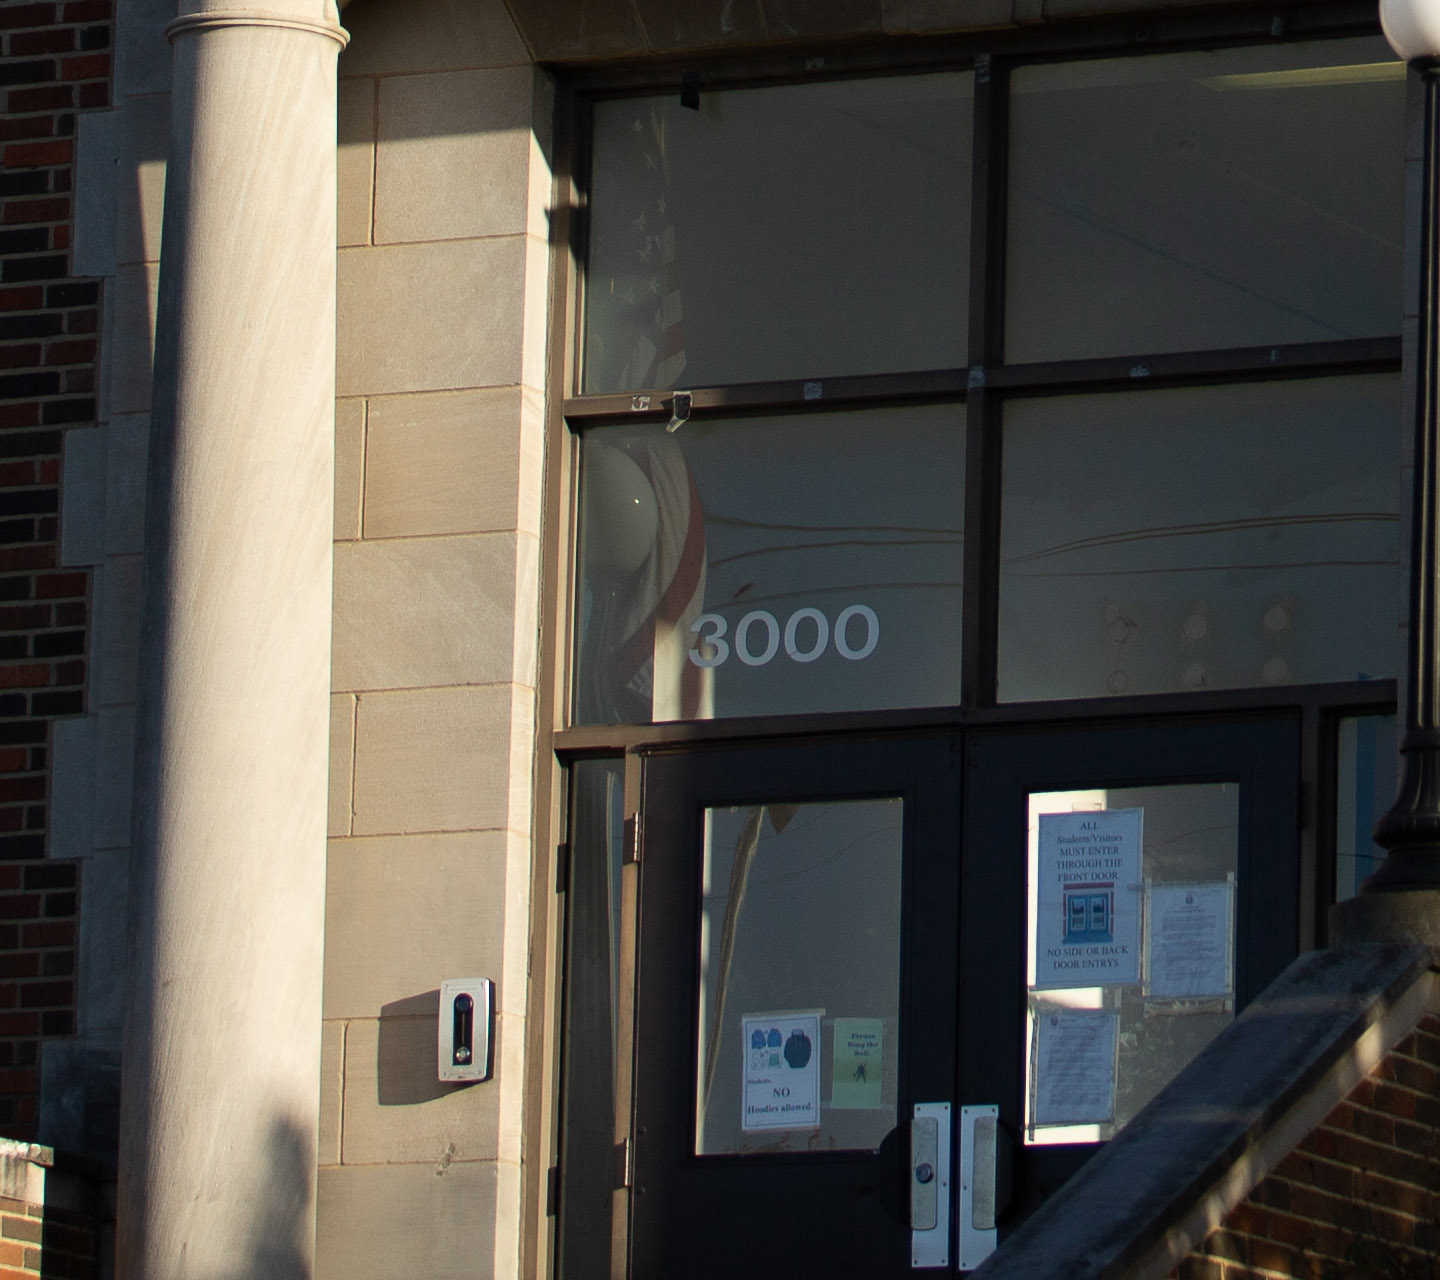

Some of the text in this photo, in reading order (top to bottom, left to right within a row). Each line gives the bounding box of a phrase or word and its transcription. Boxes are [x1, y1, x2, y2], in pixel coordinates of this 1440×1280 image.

[688, 604, 881, 669] 3000
[1080, 821, 1100, 830] ALL
[1060, 845, 1120, 857] MUST ENTER
[1056, 858, 1123, 870] THROUGH THE
[1057, 873, 1090, 883] FRONT
[1047, 944, 1129, 957] NO SIDE OR BACK
[1053, 960, 1080, 969] DOOR
[773, 1088, 791, 1098] NO
[747, 1105, 778, 1115] Hoodies
